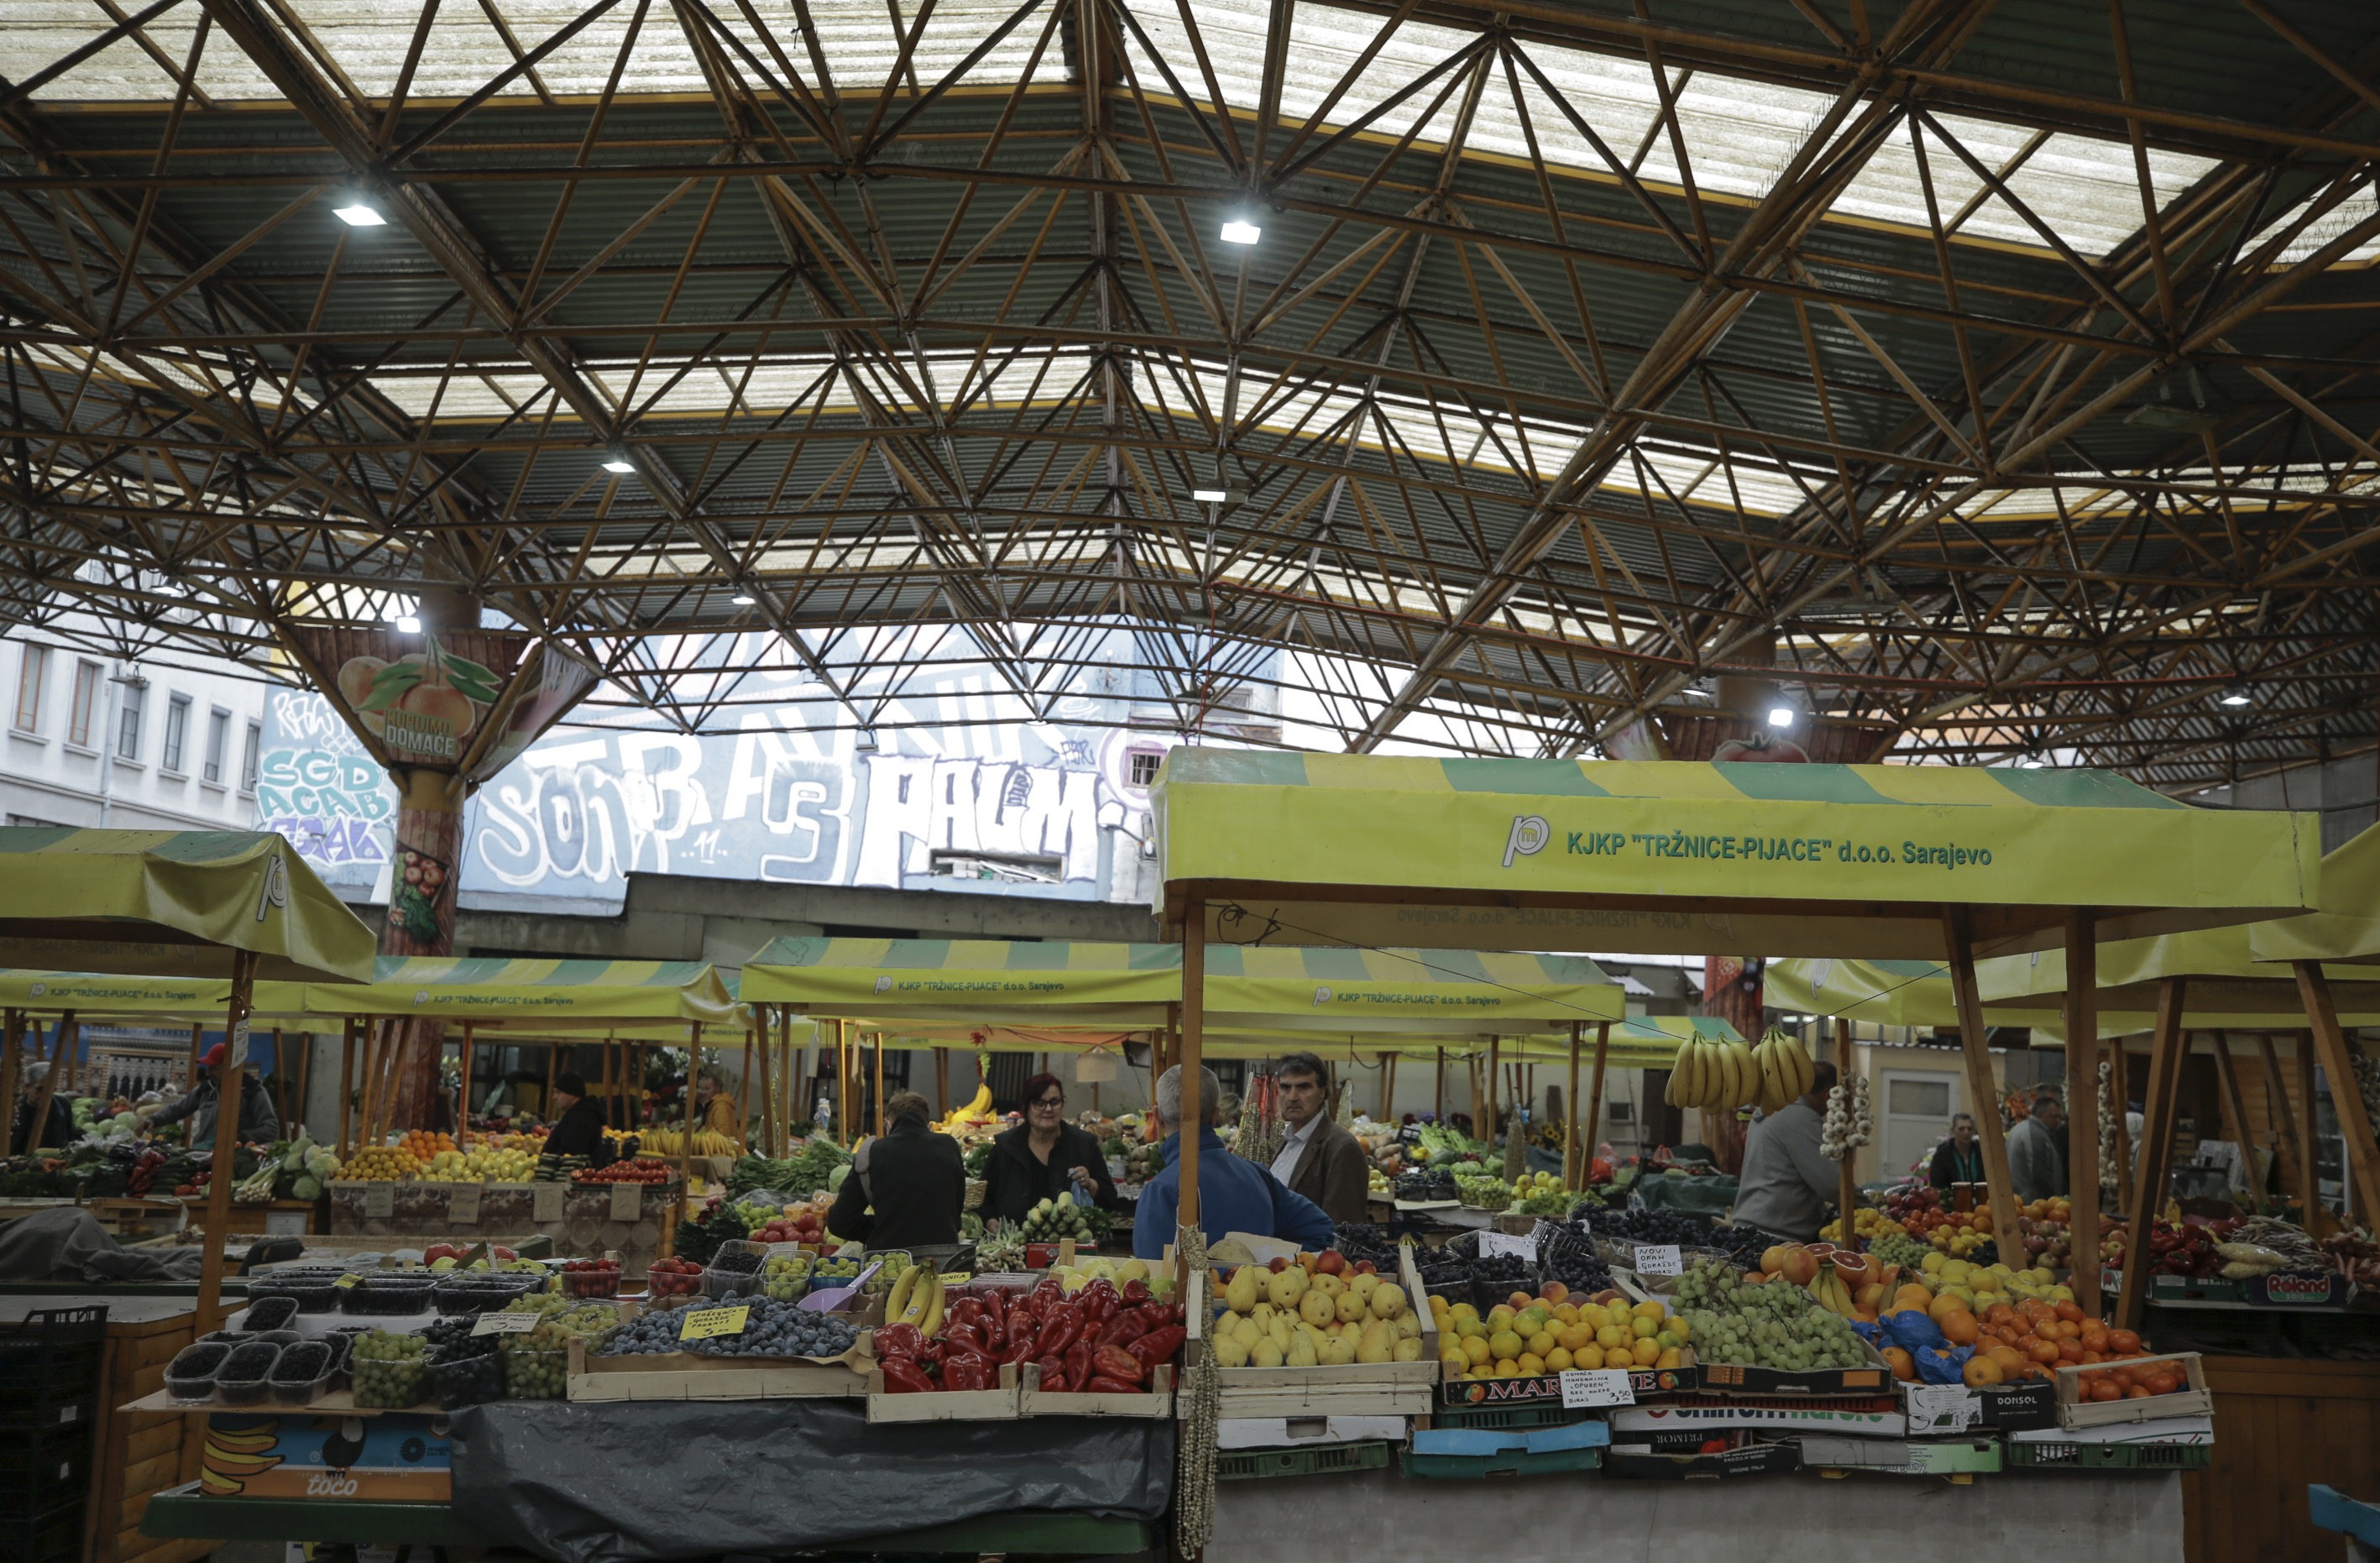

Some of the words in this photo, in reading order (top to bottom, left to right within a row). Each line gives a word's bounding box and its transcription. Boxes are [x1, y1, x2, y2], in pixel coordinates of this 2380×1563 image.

[385, 709, 451, 737] KUPUJMO
[386, 724, 455, 755] DOMAĆE
[263, 750, 384, 793] SGD
[257, 787, 391, 825] ACAB
[1567, 831, 1625, 855] KJKP
[1631, 829, 1832, 861] "TRŽNICE-PIJACE"
[1837, 843, 1896, 864] d.o.o.
[1901, 842, 1992, 870] Sarajevo
[898, 981, 921, 991] KJKP
[1004, 982, 1026, 991] d.o.o.
[1028, 981, 1064, 992] Sarajevo
[165, 991, 196, 1001] Sarajevo
[434, 996, 453, 1004] KJKP
[543, 996, 573, 1007] Sarajevo
[1337, 992, 1360, 1002] KJKP
[1441, 995, 1463, 1005] d.o.o.
[1466, 996, 1501, 1007] Sarajevo
[2268, 1276, 2329, 1293] Roland
[491, 1322, 508, 1330] 3
[1656, 1433, 1703, 1443] PRIMOR
